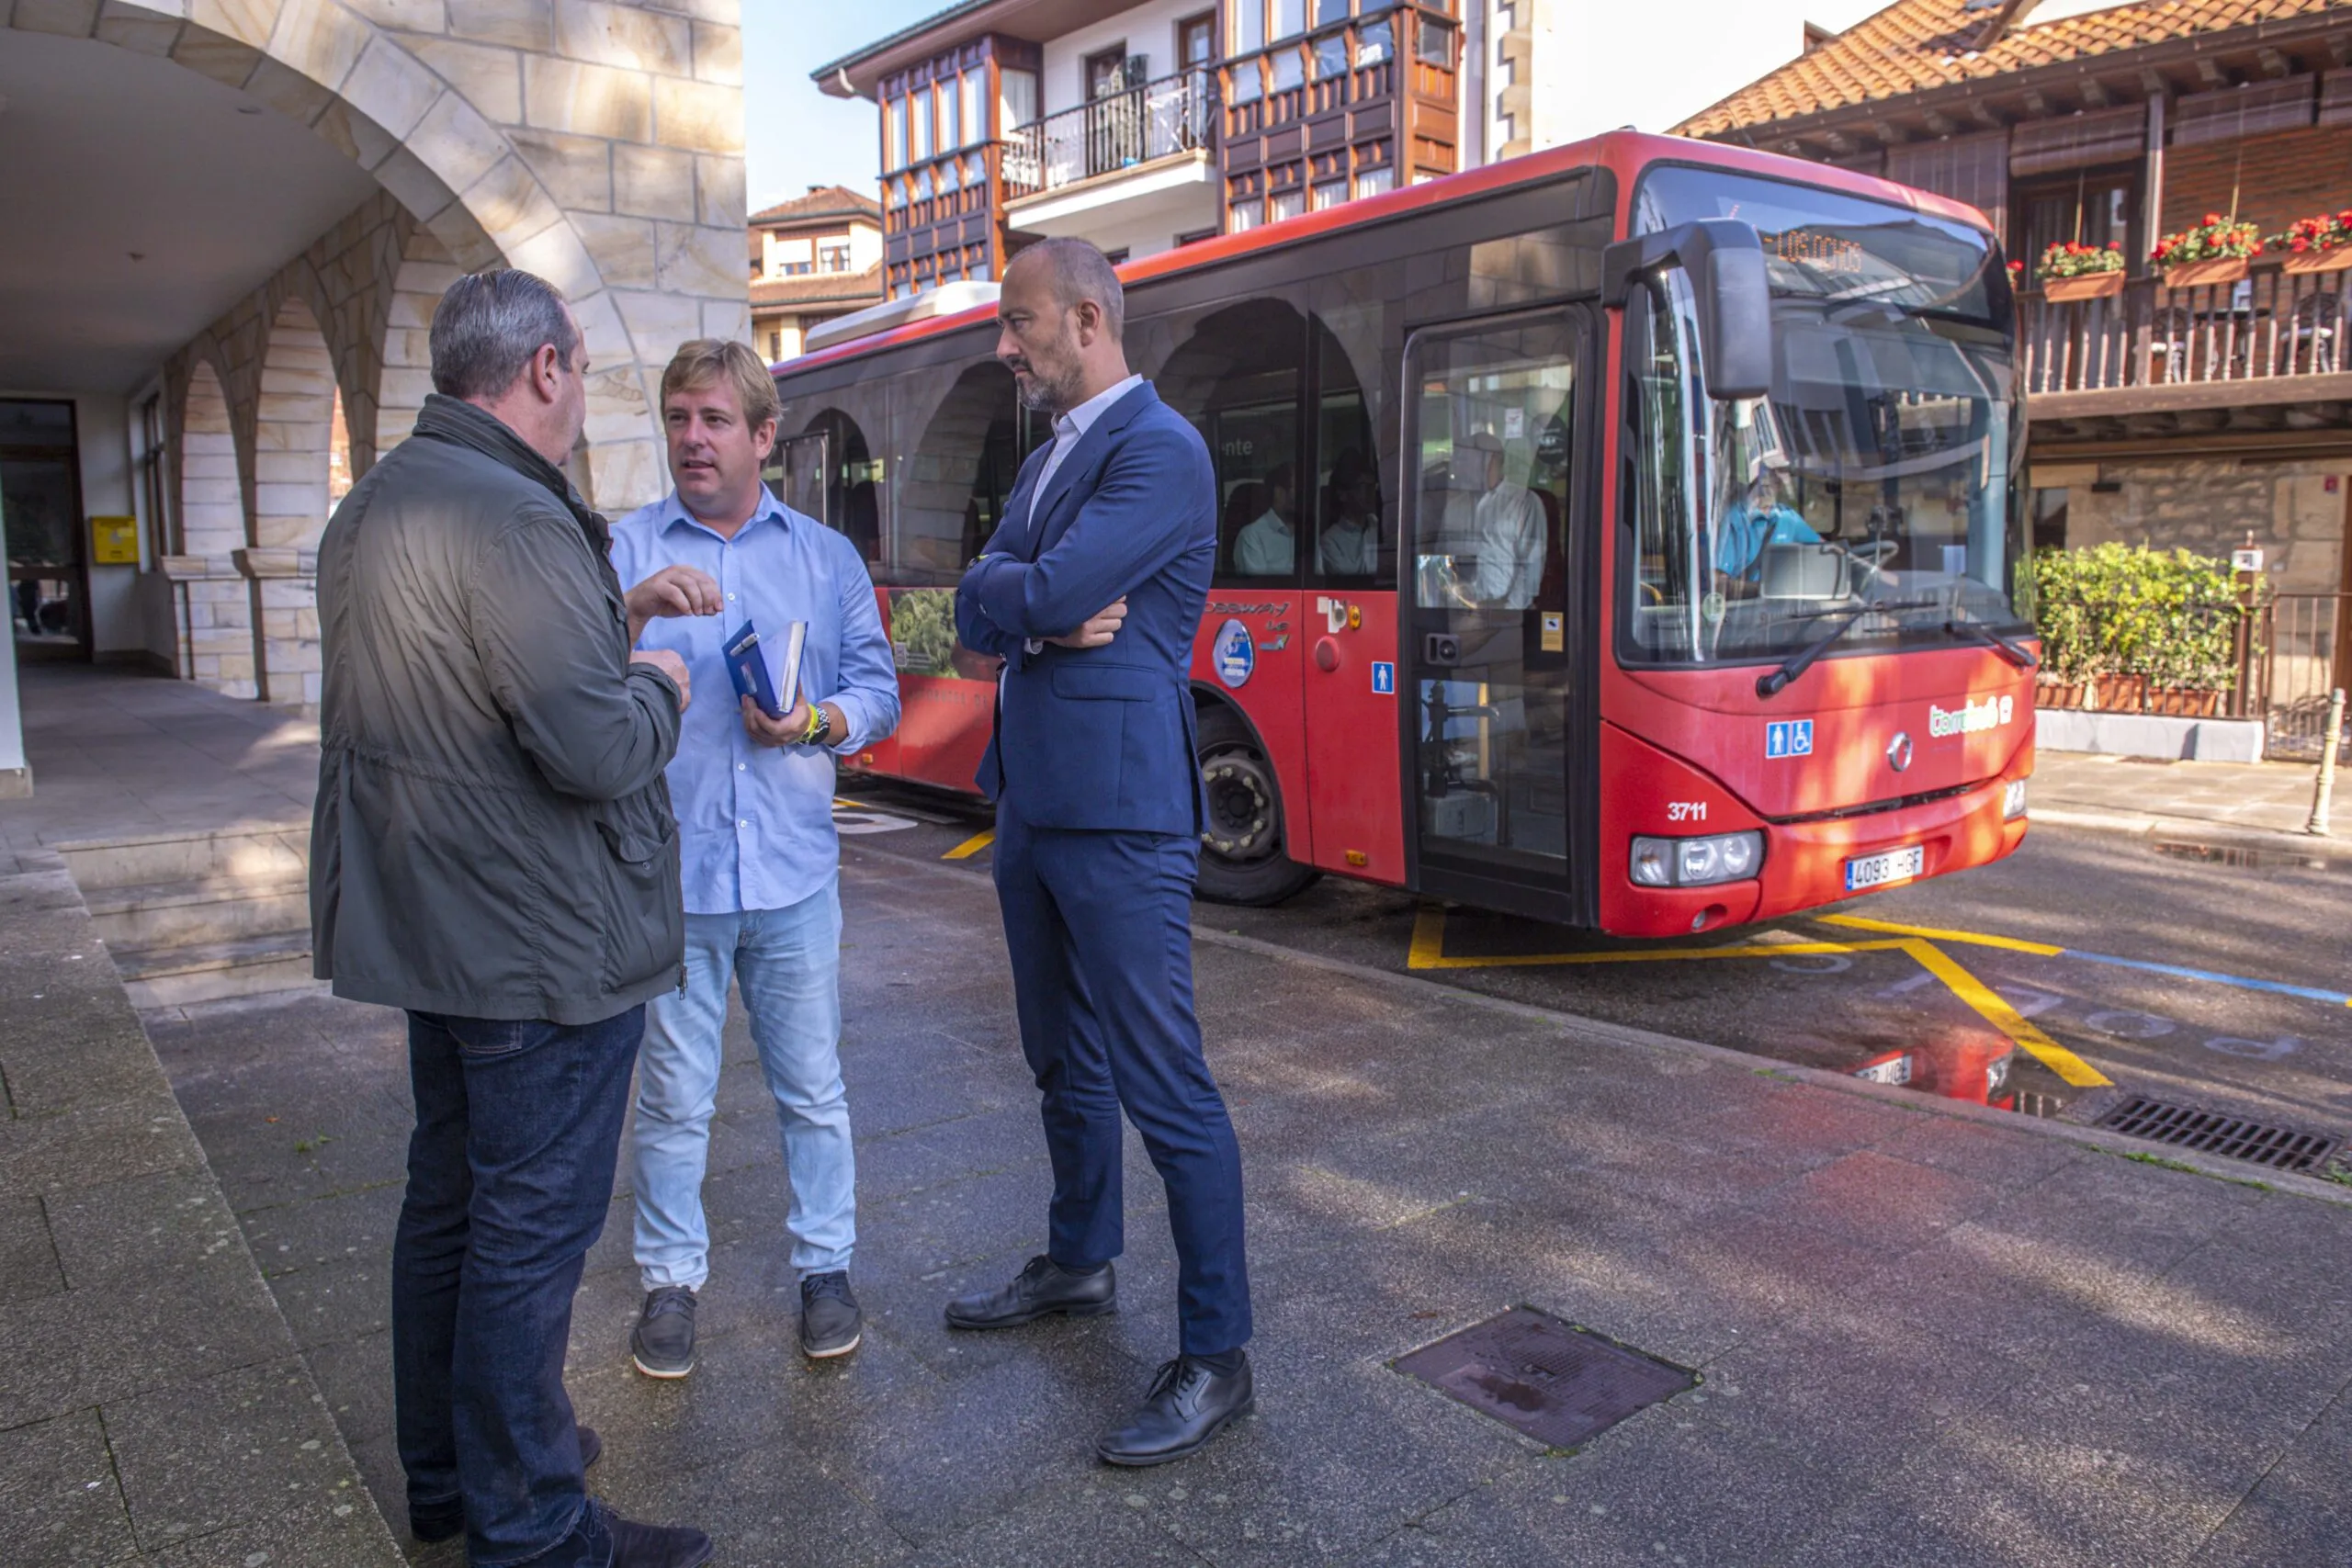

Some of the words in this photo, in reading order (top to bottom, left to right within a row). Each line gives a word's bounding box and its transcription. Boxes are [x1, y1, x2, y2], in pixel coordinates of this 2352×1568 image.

[1667, 801, 1708, 822] 3711
[1855, 858, 1890, 885] 4093
[1895, 850, 1921, 874] HGF
